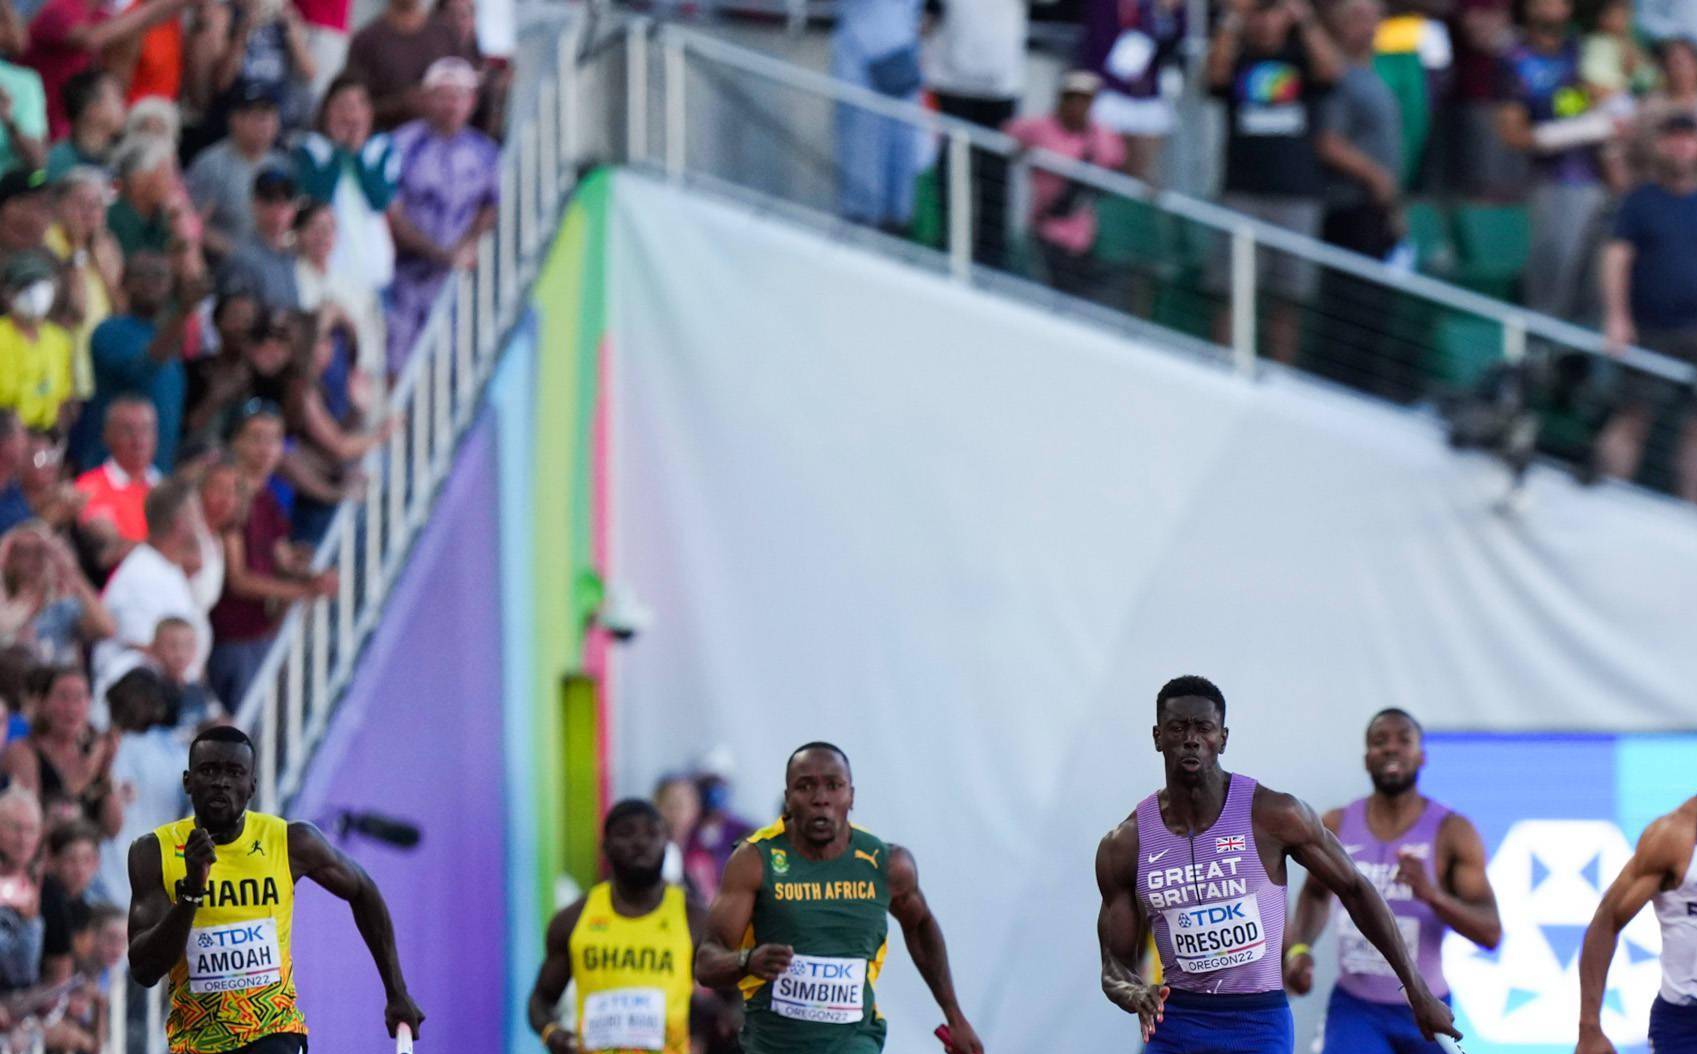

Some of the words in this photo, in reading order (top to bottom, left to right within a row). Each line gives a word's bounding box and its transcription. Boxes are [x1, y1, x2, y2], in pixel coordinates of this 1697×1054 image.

[1147, 857, 1242, 889] GREAT
[175, 877, 279, 907] HANA
[775, 881, 822, 901] SOUTH
[824, 881, 876, 900] AFRICA
[1148, 878, 1247, 908] BRITAIN
[1190, 902, 1246, 926] TDK
[212, 925, 265, 947] TDK
[1175, 921, 1258, 954] PRESCOD
[197, 945, 272, 973] AMOAH
[583, 945, 674, 975] GHANA
[807, 961, 854, 979] TDK
[1188, 950, 1254, 971] OREGON22
[204, 975, 270, 991] OREGON22
[779, 978, 859, 1003] SIMBINE
[785, 1006, 849, 1021] OREGON22
